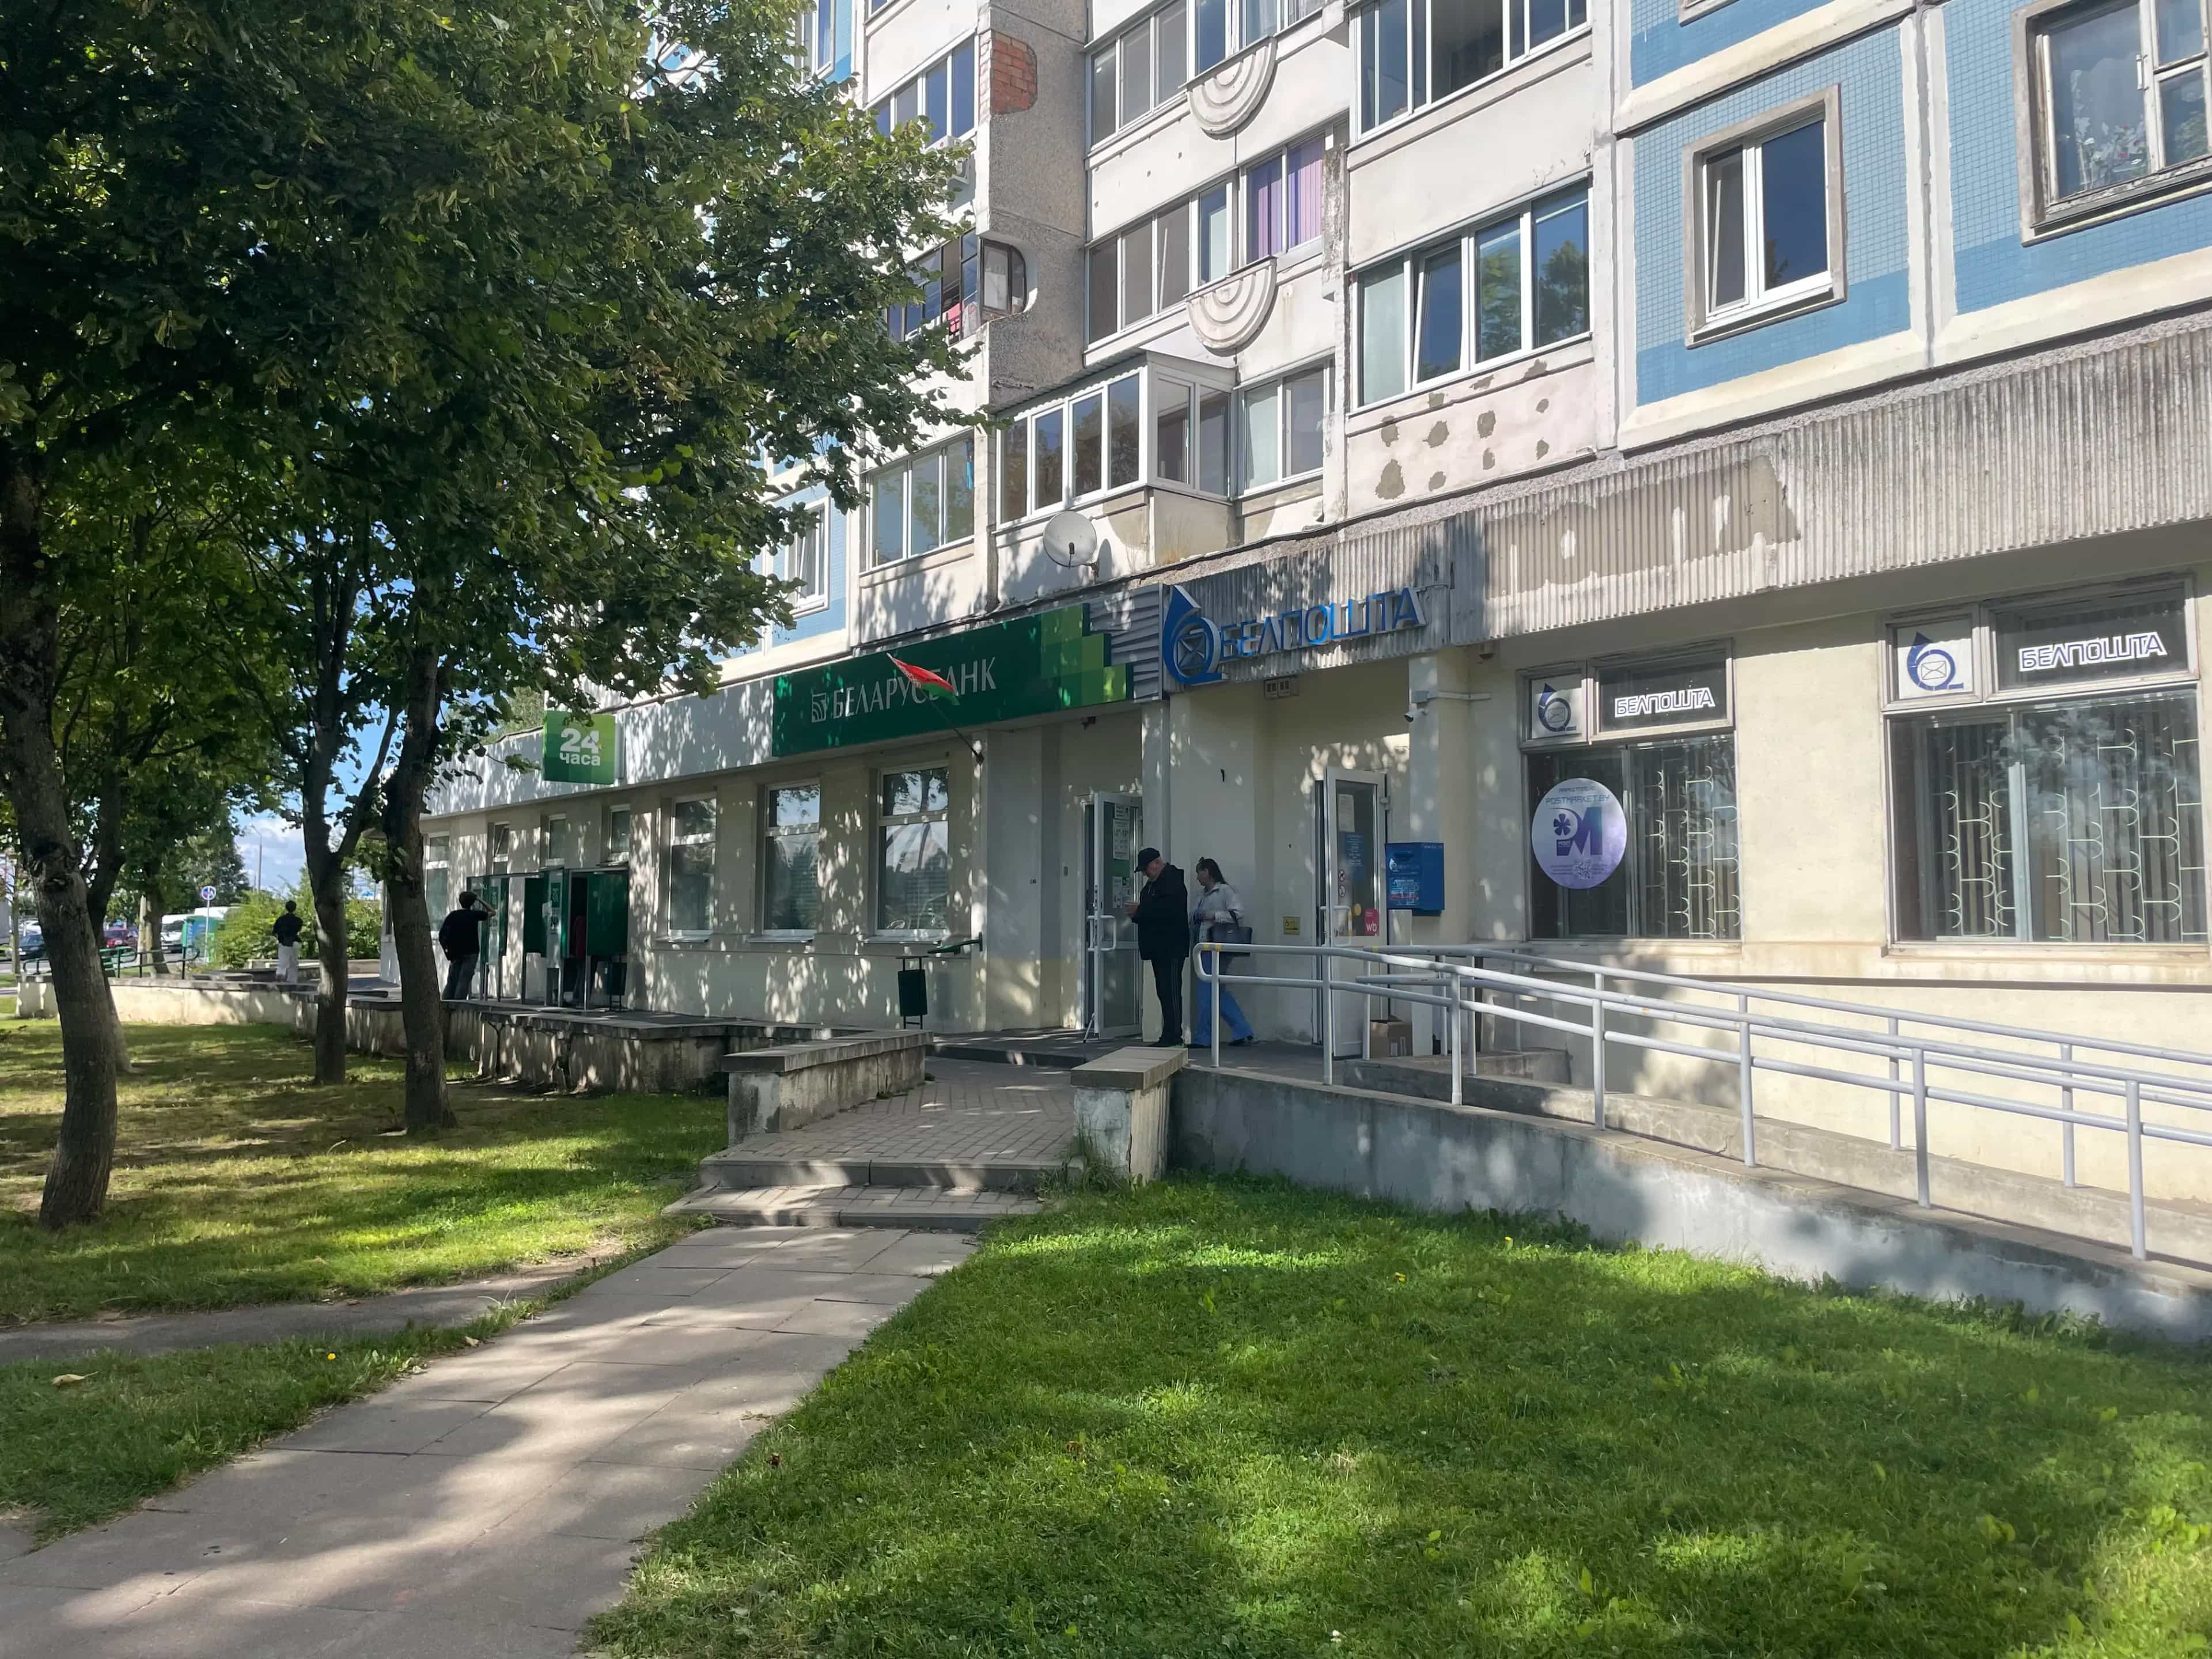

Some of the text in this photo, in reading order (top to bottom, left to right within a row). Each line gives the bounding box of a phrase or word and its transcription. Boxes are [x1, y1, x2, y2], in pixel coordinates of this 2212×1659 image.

[1221, 587, 1427, 661] БЕЛПОШТА
[2018, 632, 2168, 671] БЕЛПОШТА
[1615, 687, 1715, 717] БЕЛПОШТА
[560, 728, 600, 754] 24
[559, 752, 600, 766] часа
[1366, 920, 1377, 932] wb
